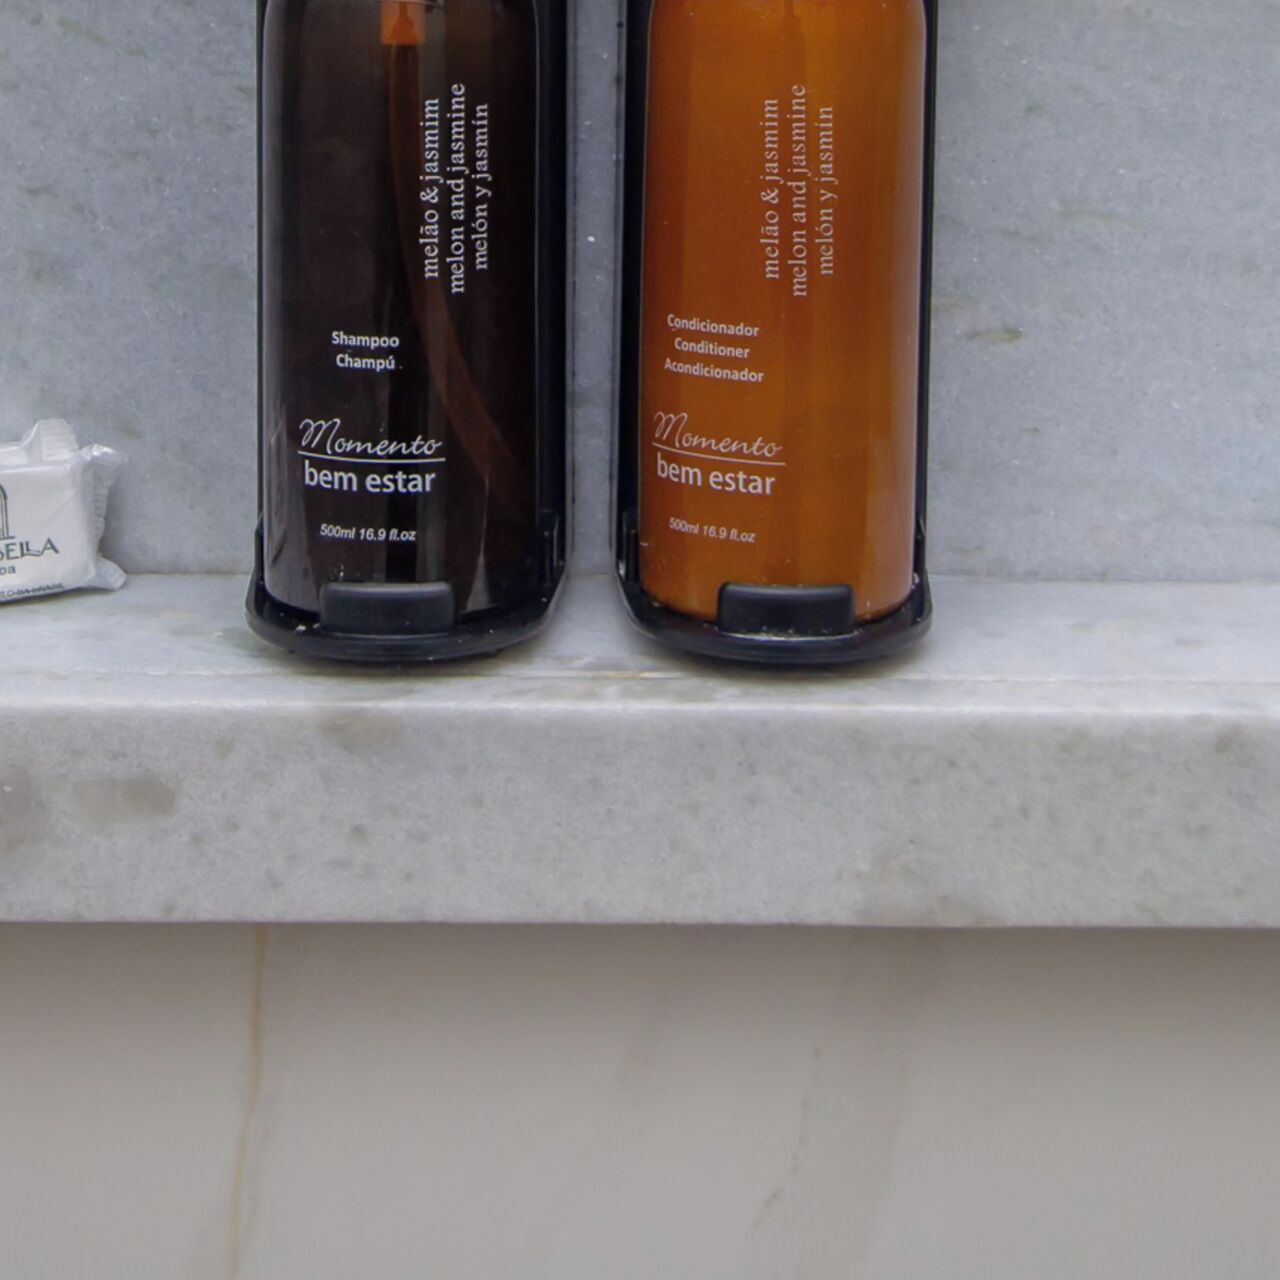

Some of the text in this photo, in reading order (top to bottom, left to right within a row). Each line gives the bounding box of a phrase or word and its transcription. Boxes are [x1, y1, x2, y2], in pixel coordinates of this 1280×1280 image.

[419, 97, 444, 280] melão & jasmim
[446, 83, 470, 295] melon and jasmine
[471, 103, 492, 270] melón y jasmín
[759, 98, 784, 280] melão & jasmim
[786, 83, 812, 297] melon and jasmine
[814, 106, 839, 276] melón y jasmín
[331, 330, 400, 351] Shampoo
[667, 313, 760, 338] Condicionador
[335, 353, 396, 373] Champú
[673, 337, 751, 359] Conditioner
[663, 357, 765, 383] Acondicionador
[298, 417, 443, 456] Momento
[652, 411, 783, 458] Momento
[304, 459, 437, 494] bem estar
[656, 451, 776, 496] bem estar
[320, 523, 356, 540] 500ml
[359, 527, 387, 542] 16.9
